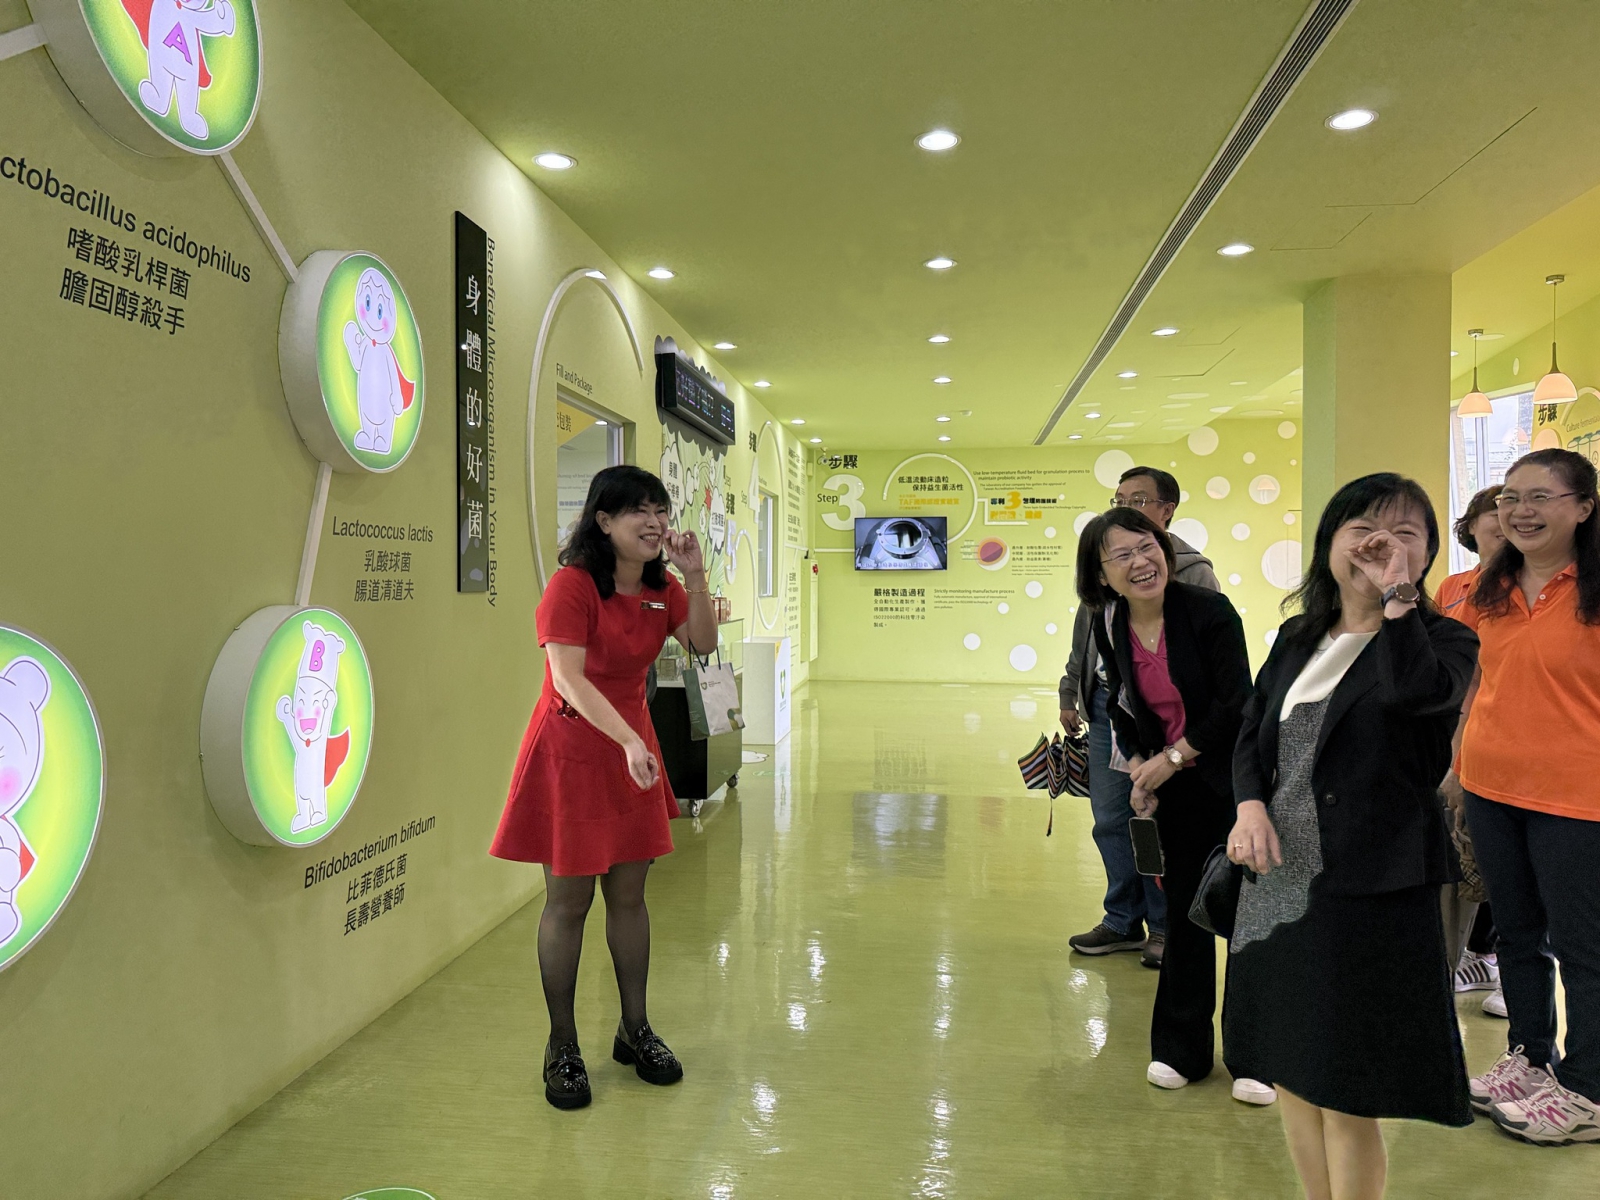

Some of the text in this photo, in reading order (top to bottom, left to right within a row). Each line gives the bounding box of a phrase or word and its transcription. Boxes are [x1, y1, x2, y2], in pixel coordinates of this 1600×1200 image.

[163, 21, 193, 66] A
[0, 156, 251, 283] ctobacillus acidophilus
[67, 227, 191, 300] 嗜酸乳桿菌
[59, 267, 186, 335] 膽固醇殺手
[556, 362, 593, 395] Fill and Package
[465, 274, 483, 540] 身體的好菌
[487, 237, 497, 607] Beneficial Microorganism in Your Body
[828, 454, 858, 469] 步驟
[817, 493, 838, 504] Step
[332, 516, 434, 542] Lactococcus lactis
[364, 549, 412, 573] 乳酸球菌
[354, 579, 414, 602] 腸道清道夫
[309, 640, 325, 672] B
[304, 815, 436, 889] Bifidobacterium bifidum
[346, 853, 408, 904] 比菲德氏菌
[344, 882, 405, 936] 長壽營養師
